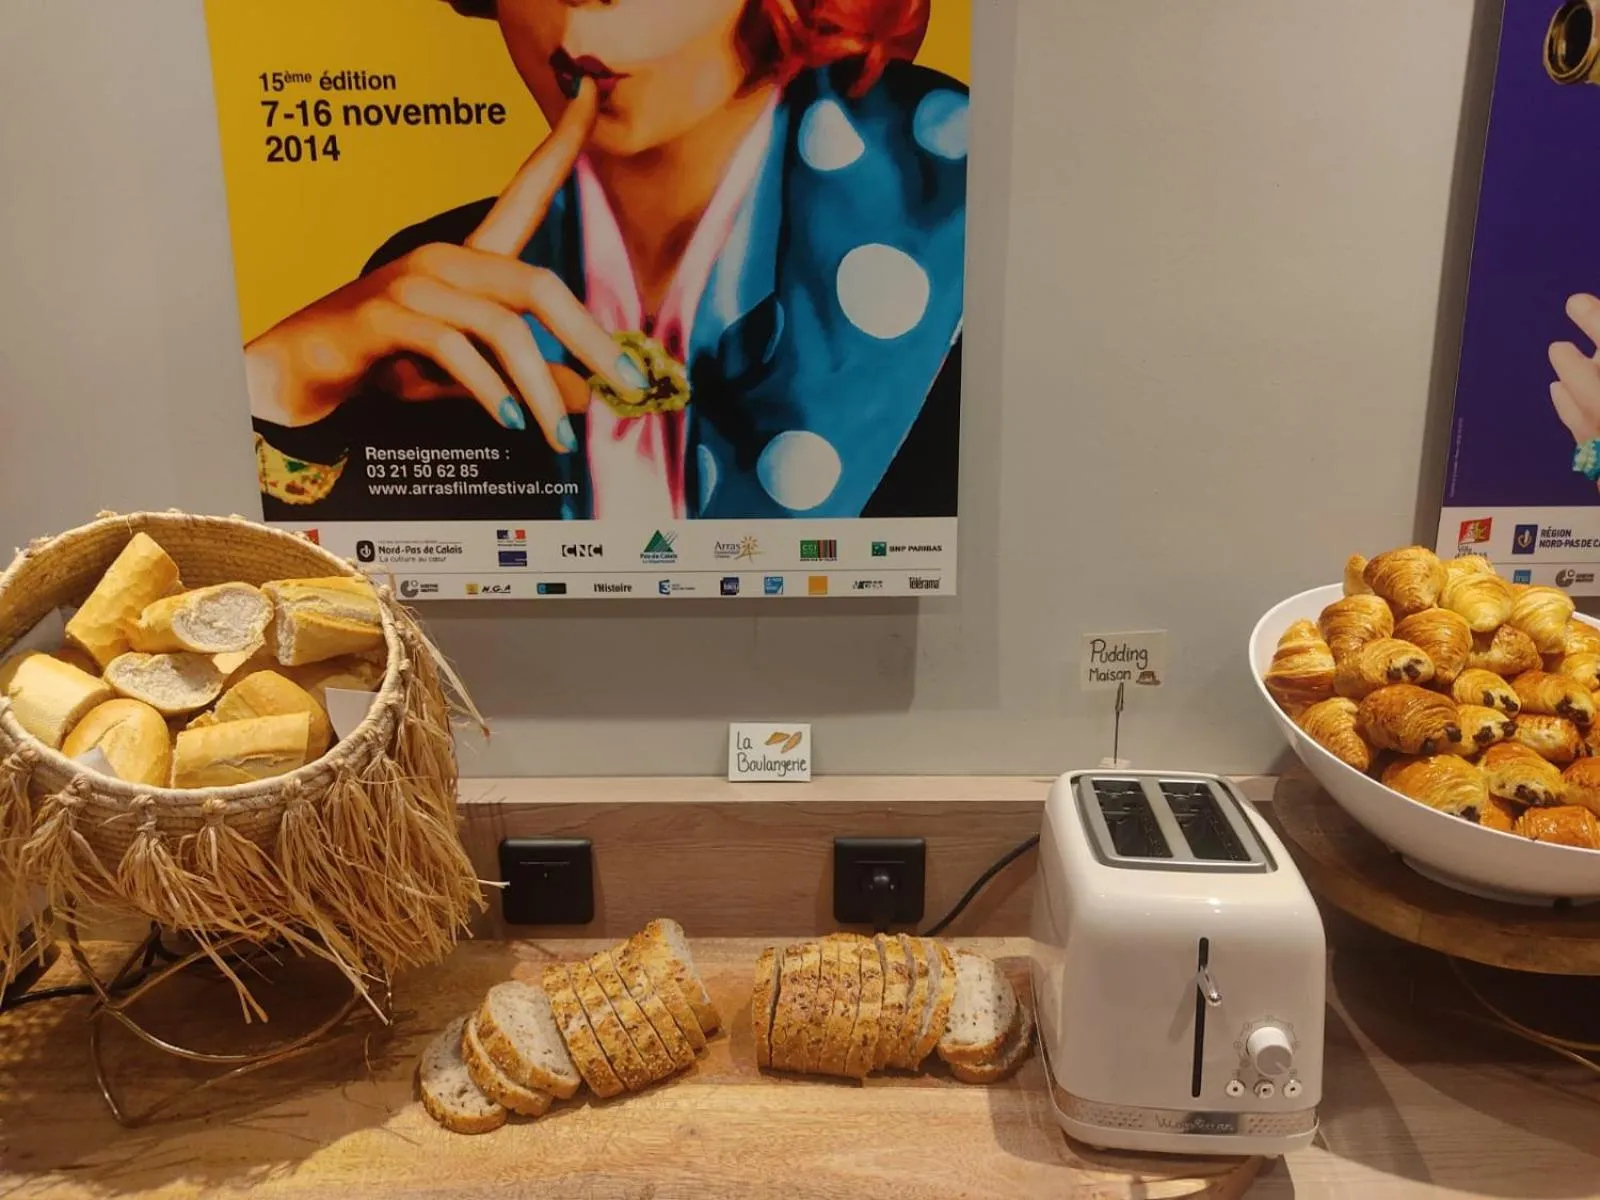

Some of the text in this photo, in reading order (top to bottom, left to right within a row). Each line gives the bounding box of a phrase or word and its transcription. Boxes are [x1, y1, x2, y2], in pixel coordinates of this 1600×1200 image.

[319, 70, 396, 91] édition
[261, 97, 506, 127] 7-16 novembre
[265, 134, 341, 163] 2014
[365, 446, 500, 464] Renseignements
[366, 464, 479, 478] 03 21 50 62 85
[368, 480, 579, 496] www.arrasfilmfestival.com
[1540, 526, 1571, 538] RÉGION
[436, 545, 463, 554] Calais
[714, 541, 741, 551] Arras
[1089, 638, 1149, 670] Pudding
[1088, 668, 1132, 682] Maison
[737, 731, 753, 750] La
[736, 752, 807, 777] Boulangerie
